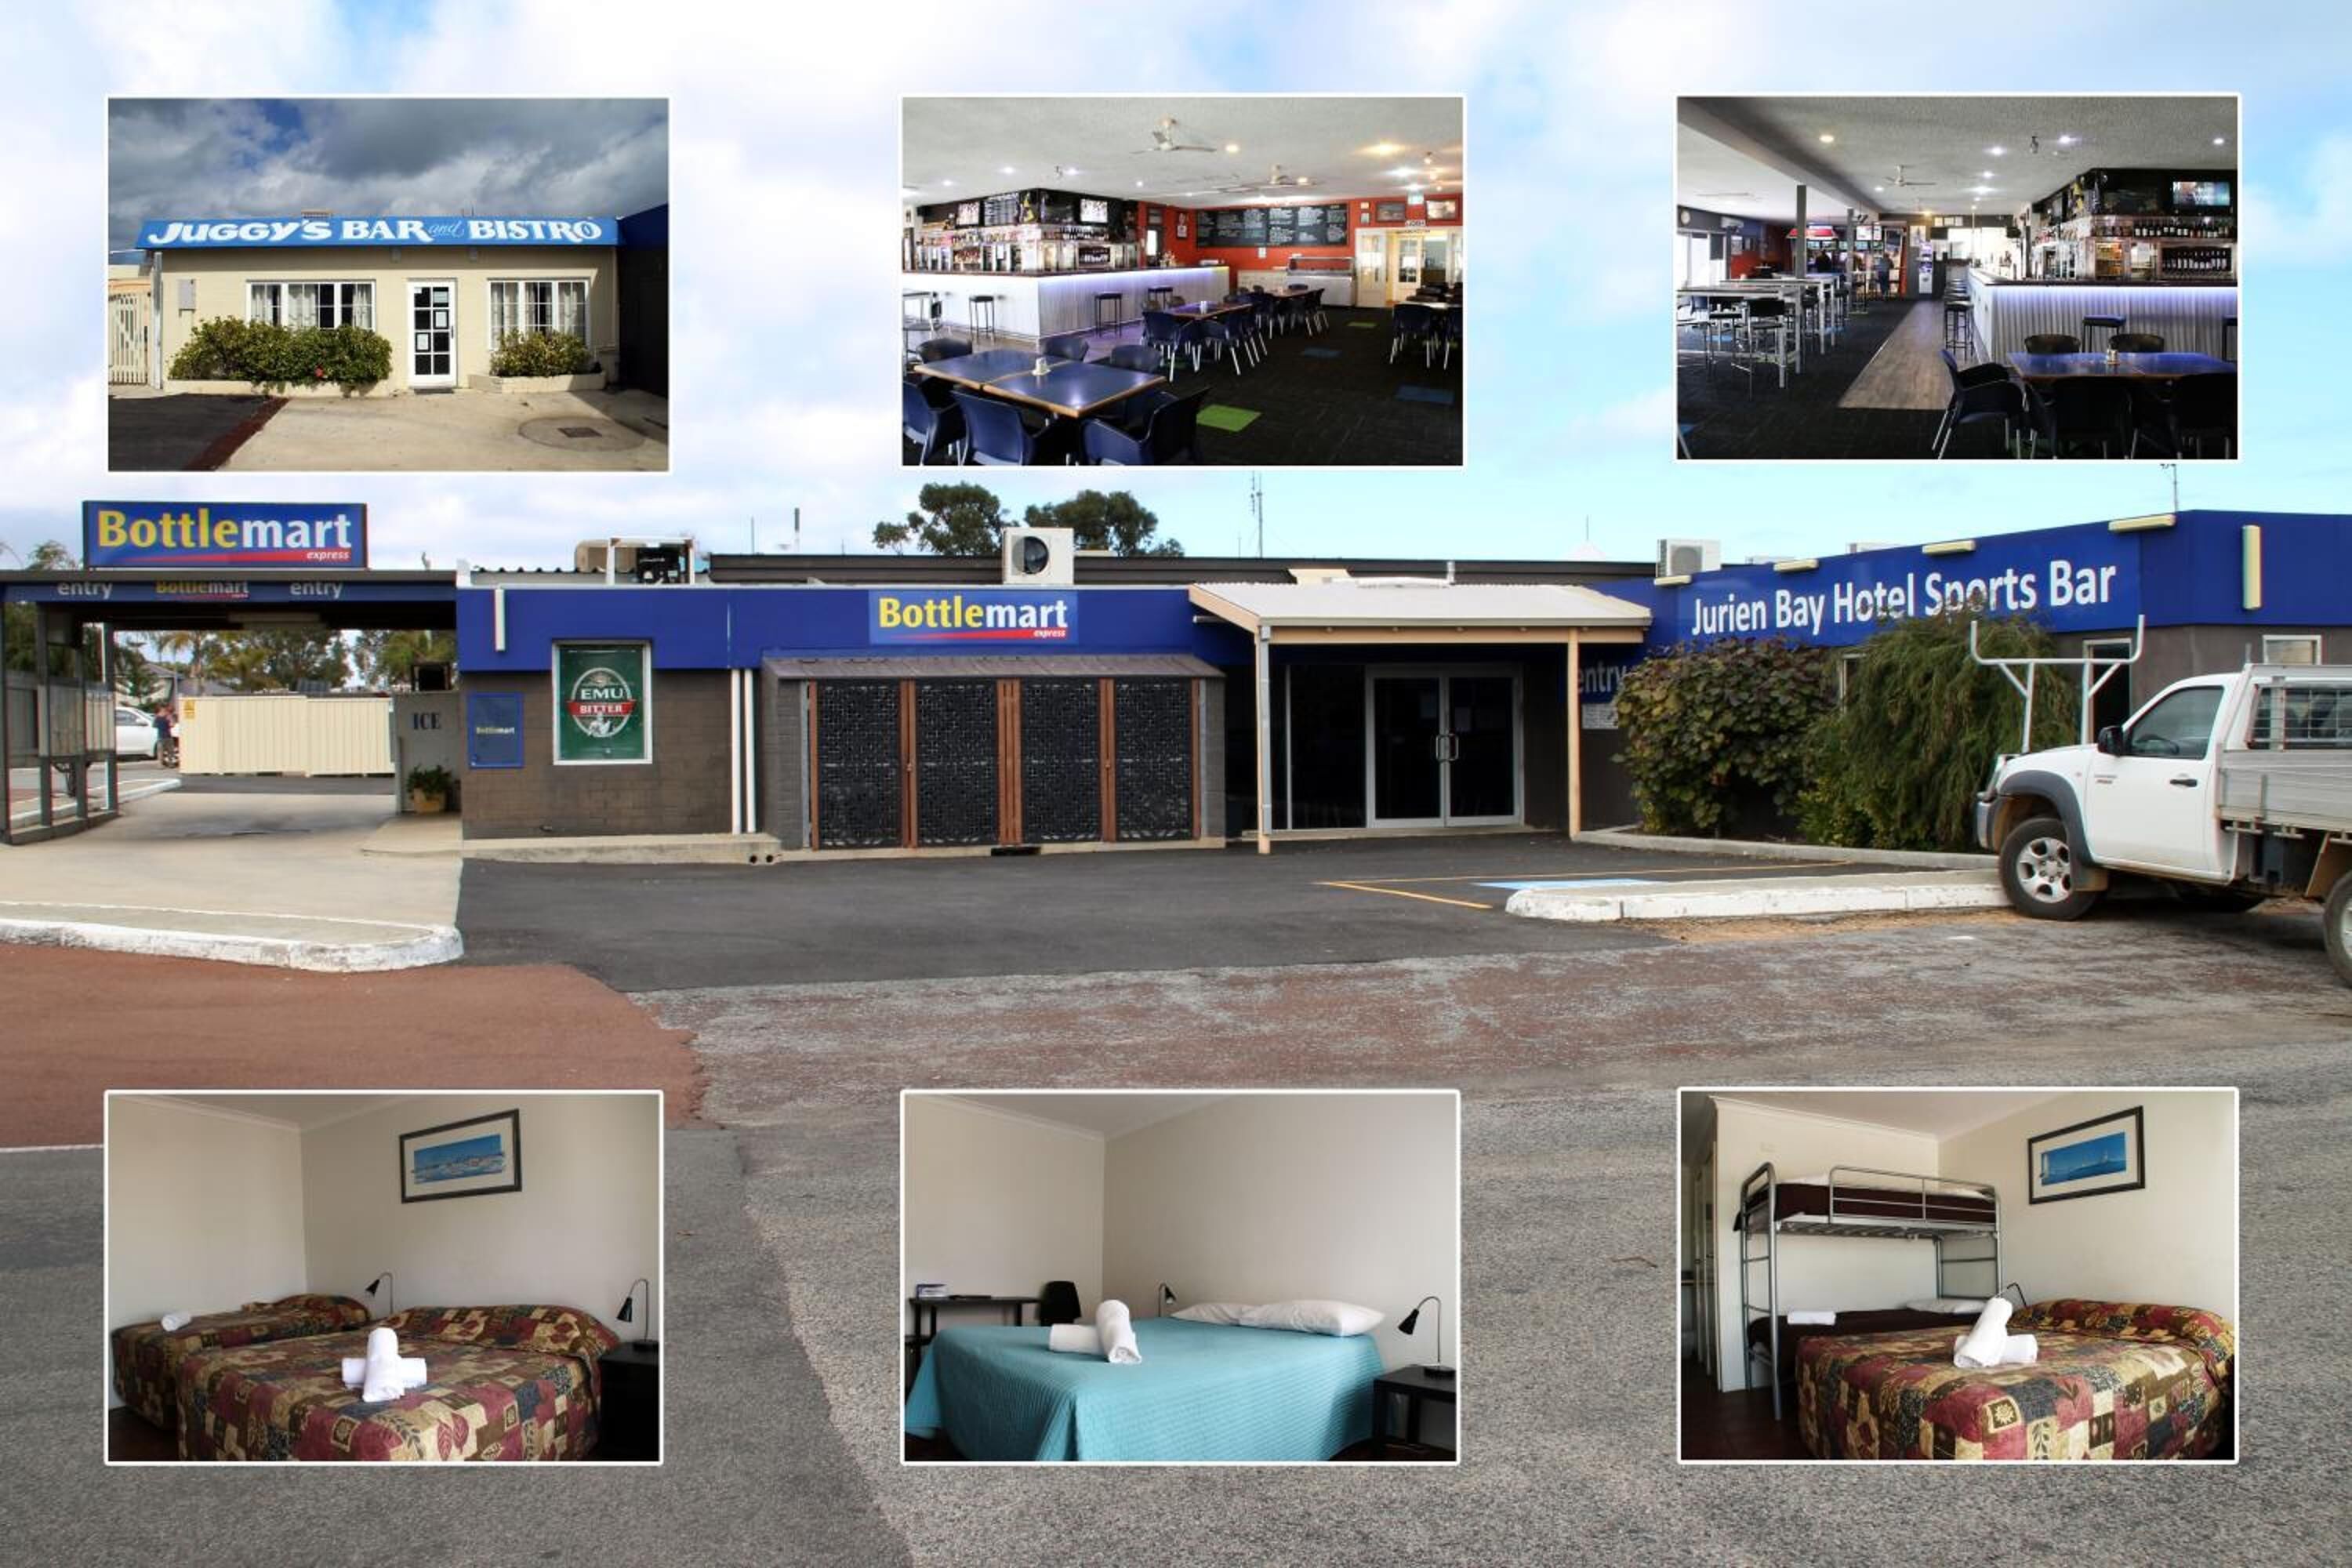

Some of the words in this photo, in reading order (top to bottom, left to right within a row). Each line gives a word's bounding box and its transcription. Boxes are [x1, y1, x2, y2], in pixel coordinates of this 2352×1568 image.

[341, 220, 434, 243] BAR
[428, 220, 464, 238] and
[466, 218, 603, 243] BISTRO
[97, 508, 352, 549] Bottlemart
[306, 550, 350, 561] express
[56, 580, 114, 600] entry
[289, 580, 343, 599] entry
[1691, 593, 1767, 636] Jurien
[1775, 589, 1826, 636] Bay
[1833, 572, 1915, 624] Hotel
[1924, 568, 2037, 625] Sports
[2049, 559, 2117, 607] Bar
[879, 595, 1069, 628] Bottlemart
[1033, 629, 1066, 639] express
[580, 688, 624, 700] EMU
[412, 712, 441, 730] ICE
